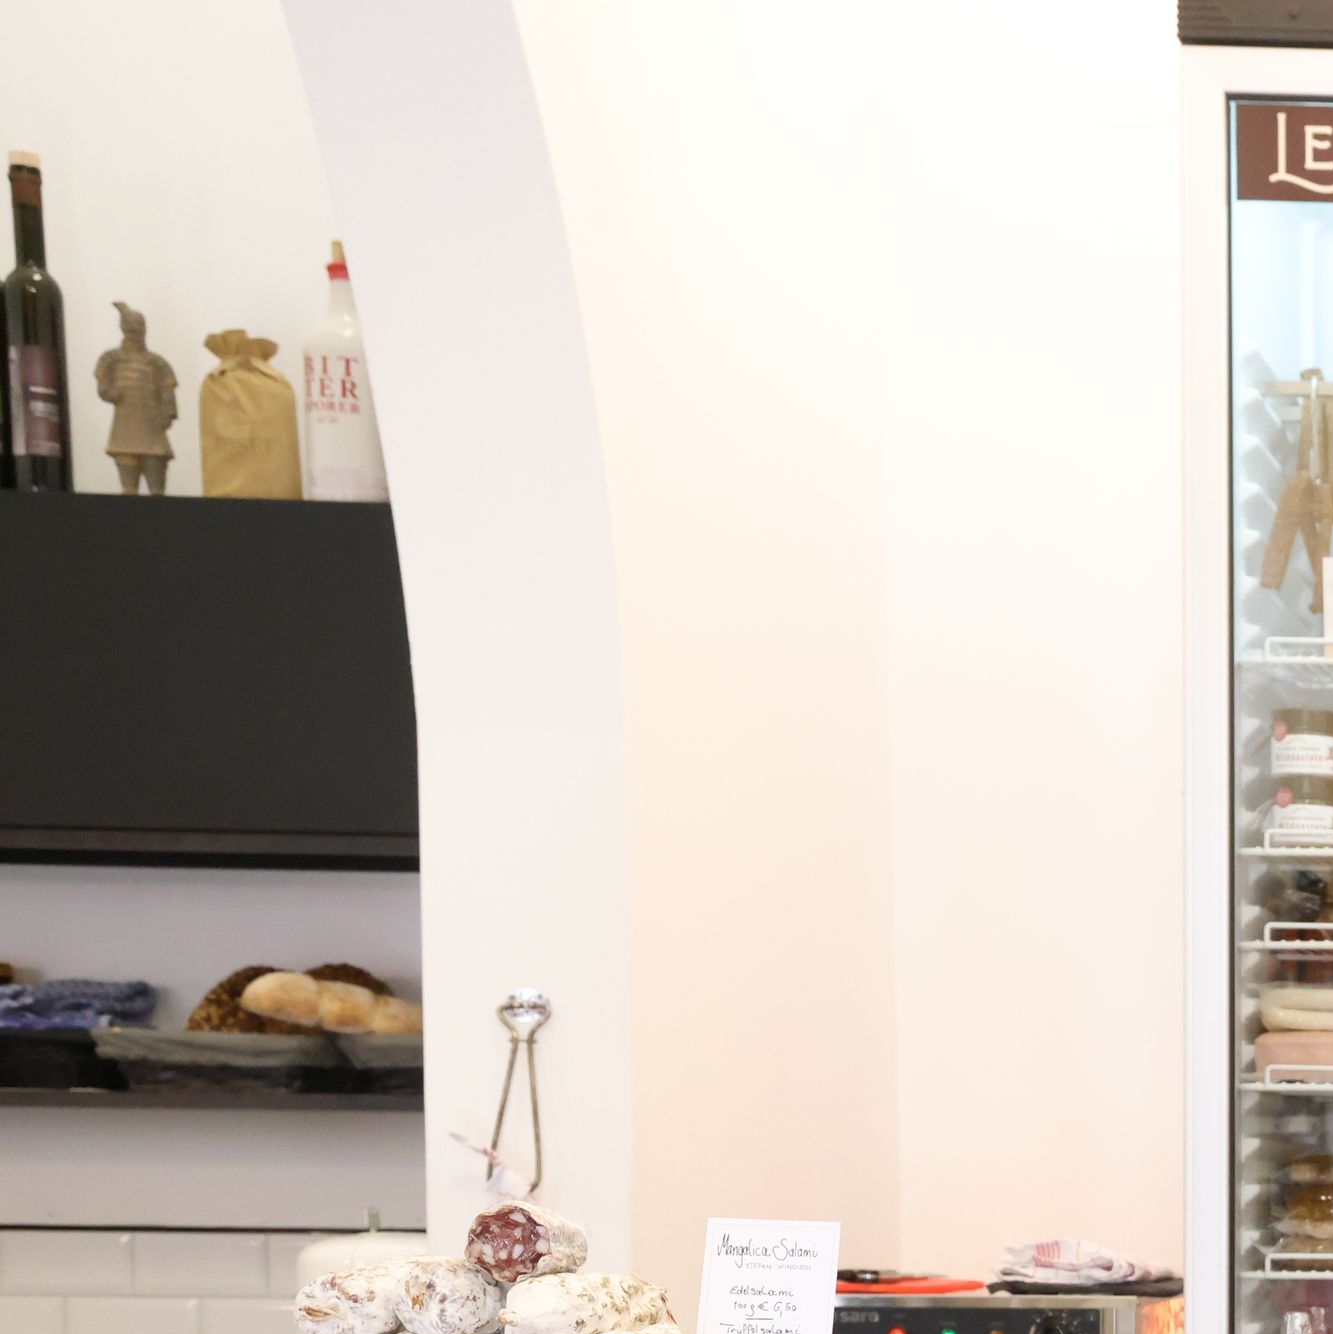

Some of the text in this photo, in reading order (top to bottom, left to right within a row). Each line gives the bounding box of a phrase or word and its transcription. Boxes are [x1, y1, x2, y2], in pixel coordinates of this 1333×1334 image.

[717, 1233, 818, 1268] Mangalica Salami
[773, 1302, 797, 1318] 6,50
